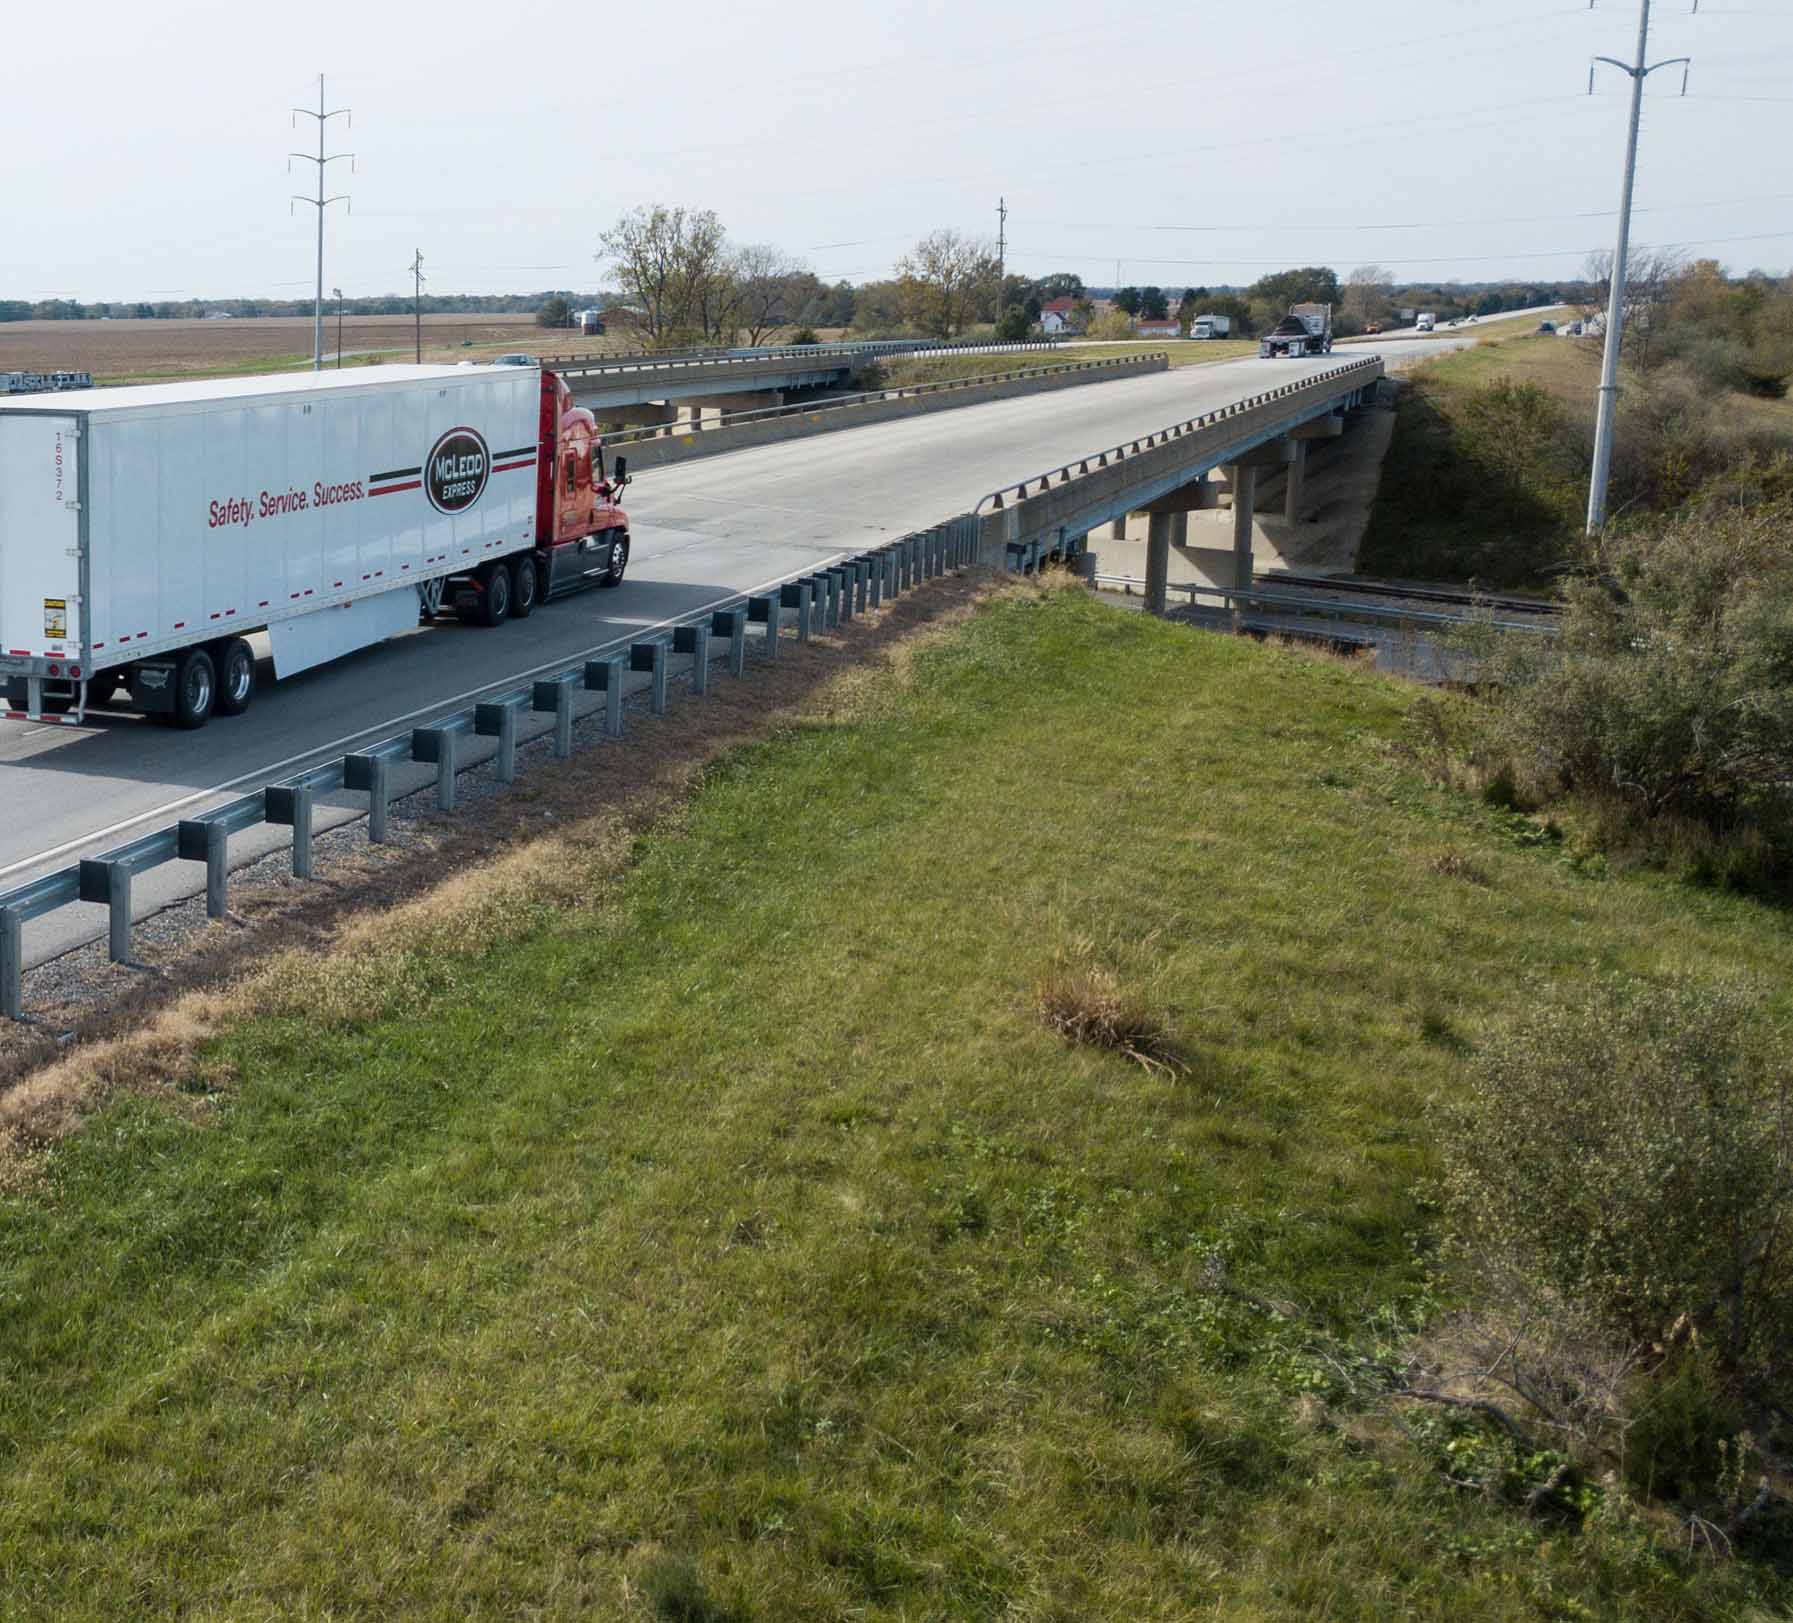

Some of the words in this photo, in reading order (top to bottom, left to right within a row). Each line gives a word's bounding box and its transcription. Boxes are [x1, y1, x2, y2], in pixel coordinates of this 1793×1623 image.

[209, 498, 254, 528] Safety.
[259, 487, 309, 518] Service.
[313, 480, 365, 507] Success.
[442, 480, 476, 500] EXPRESS
